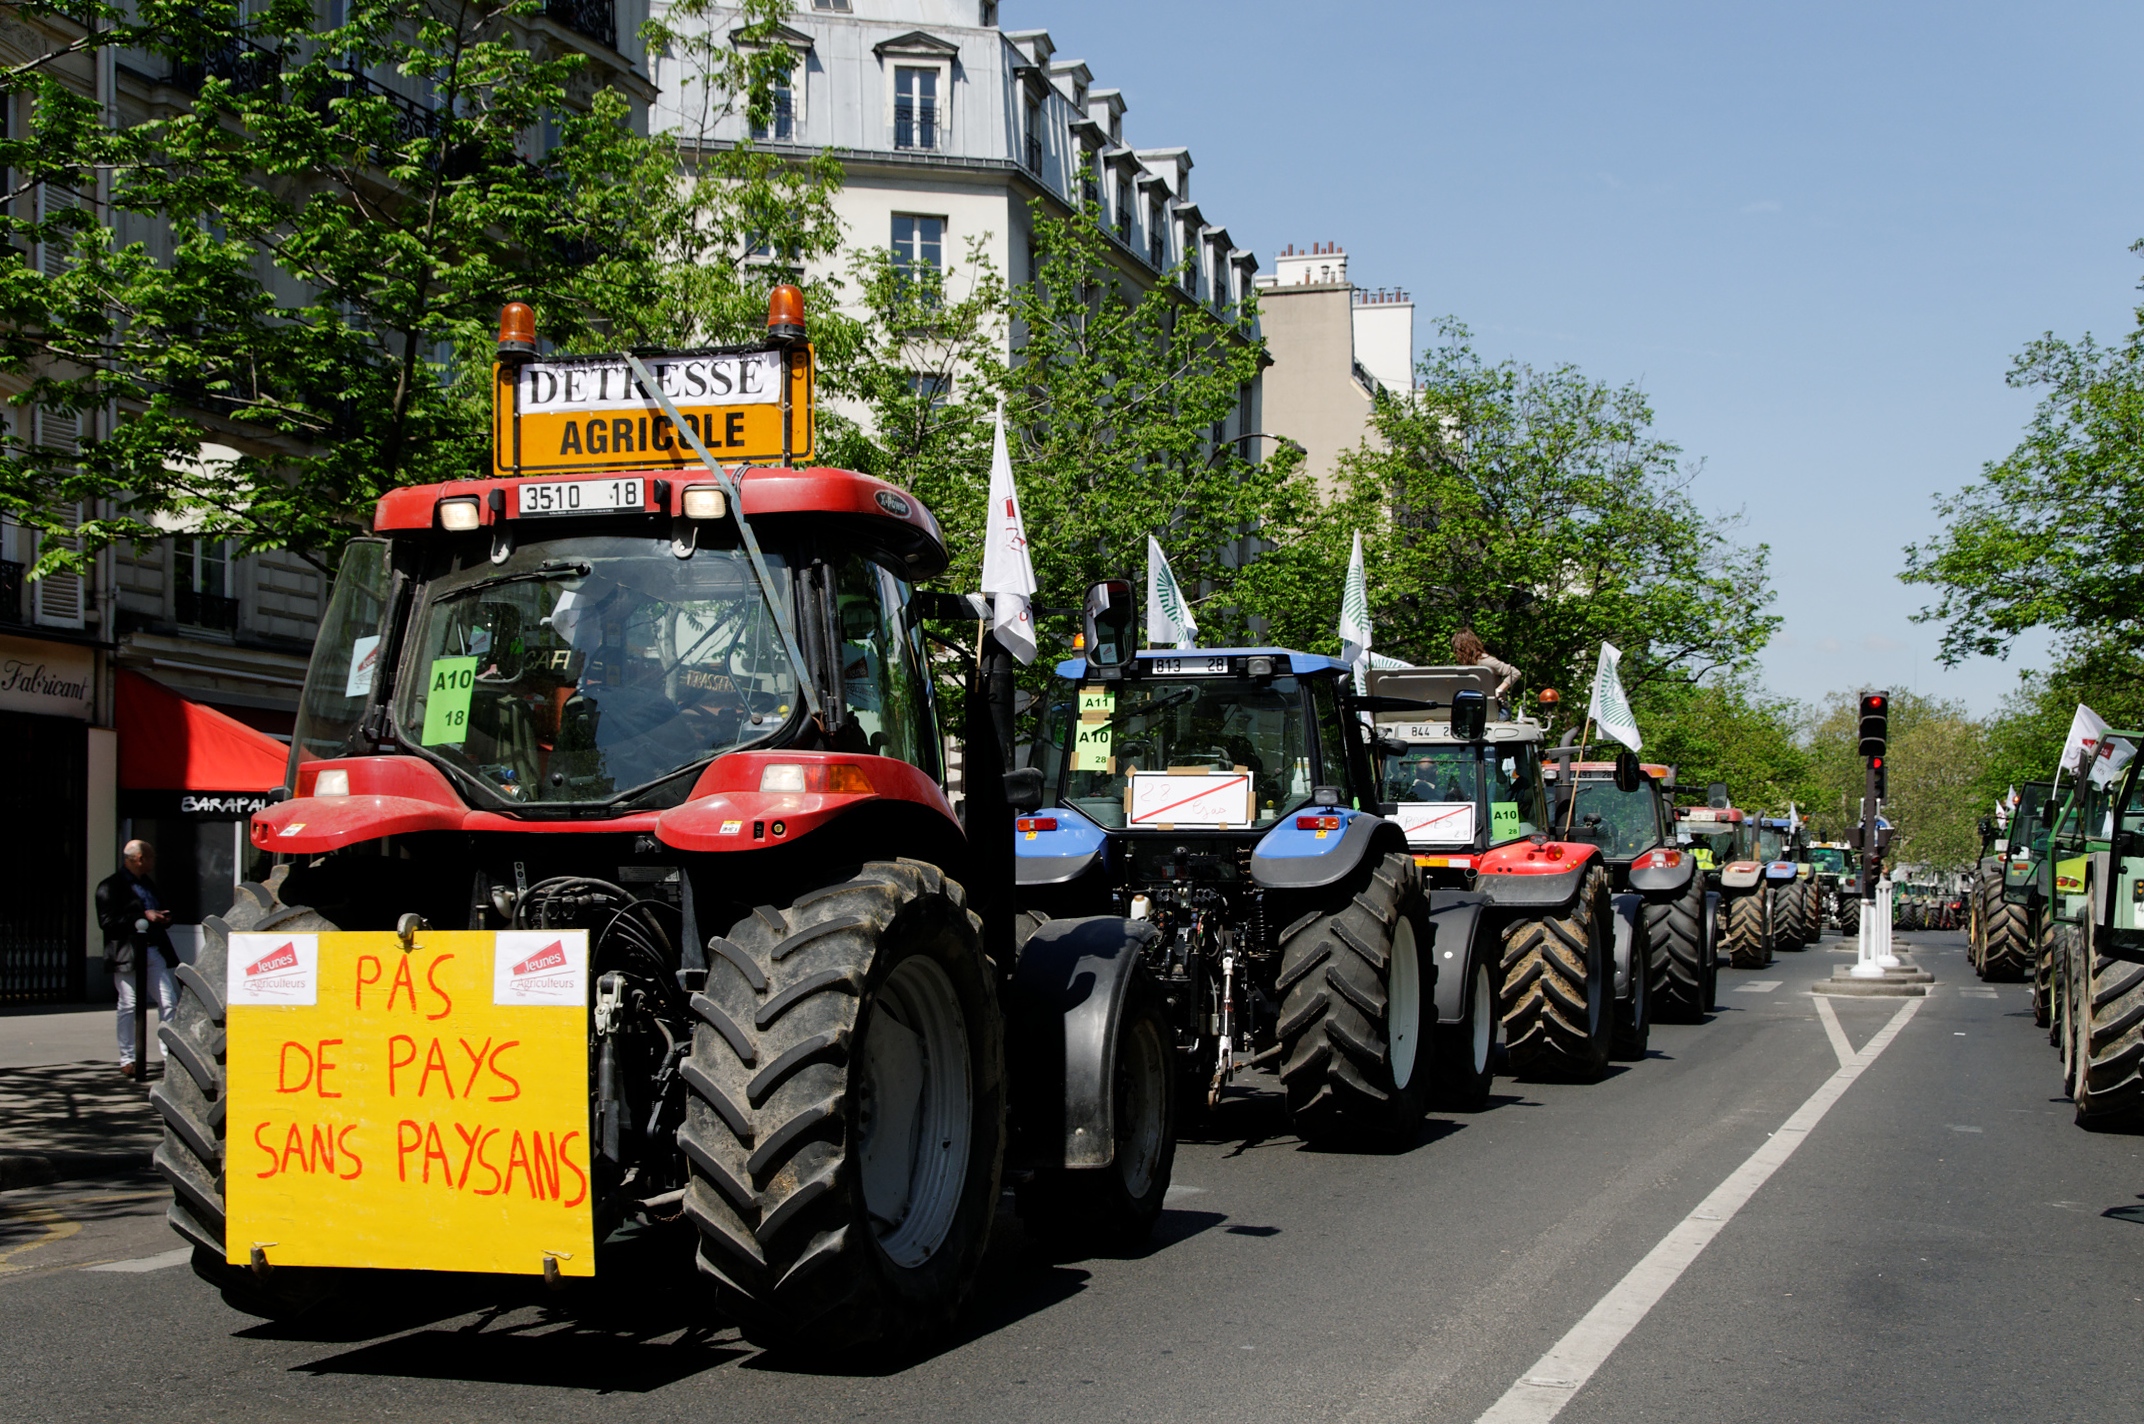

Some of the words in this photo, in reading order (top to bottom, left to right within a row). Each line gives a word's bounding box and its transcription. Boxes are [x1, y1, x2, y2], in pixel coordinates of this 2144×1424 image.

[560, 412, 745, 456] AGRICOLE
[526, 485, 580, 510] 3510
[612, 482, 637, 506] 18
[1156, 658, 1181, 673] 813
[1207, 658, 1224, 672] 28
[1, 659, 89, 701] Fabricant
[433, 669, 472, 692] A10
[1085, 698, 1108, 708] A11
[445, 710, 465, 726] 18
[1079, 732, 1109, 743] A10
[1411, 726, 1430, 737] 844
[1494, 811, 1517, 820] A10
[256, 953, 294, 974] Jeunes
[524, 952, 562, 973] Jeunes
[249, 978, 306, 991] Agriculteurs
[355, 953, 454, 1020] PAS
[516, 978, 575, 991] Agriculteurs
[275, 1038, 343, 1098] DE
[388, 1034, 521, 1102] PAYS
[254, 1121, 363, 1180] SANS
[397, 1119, 588, 1208] PAYSANS
